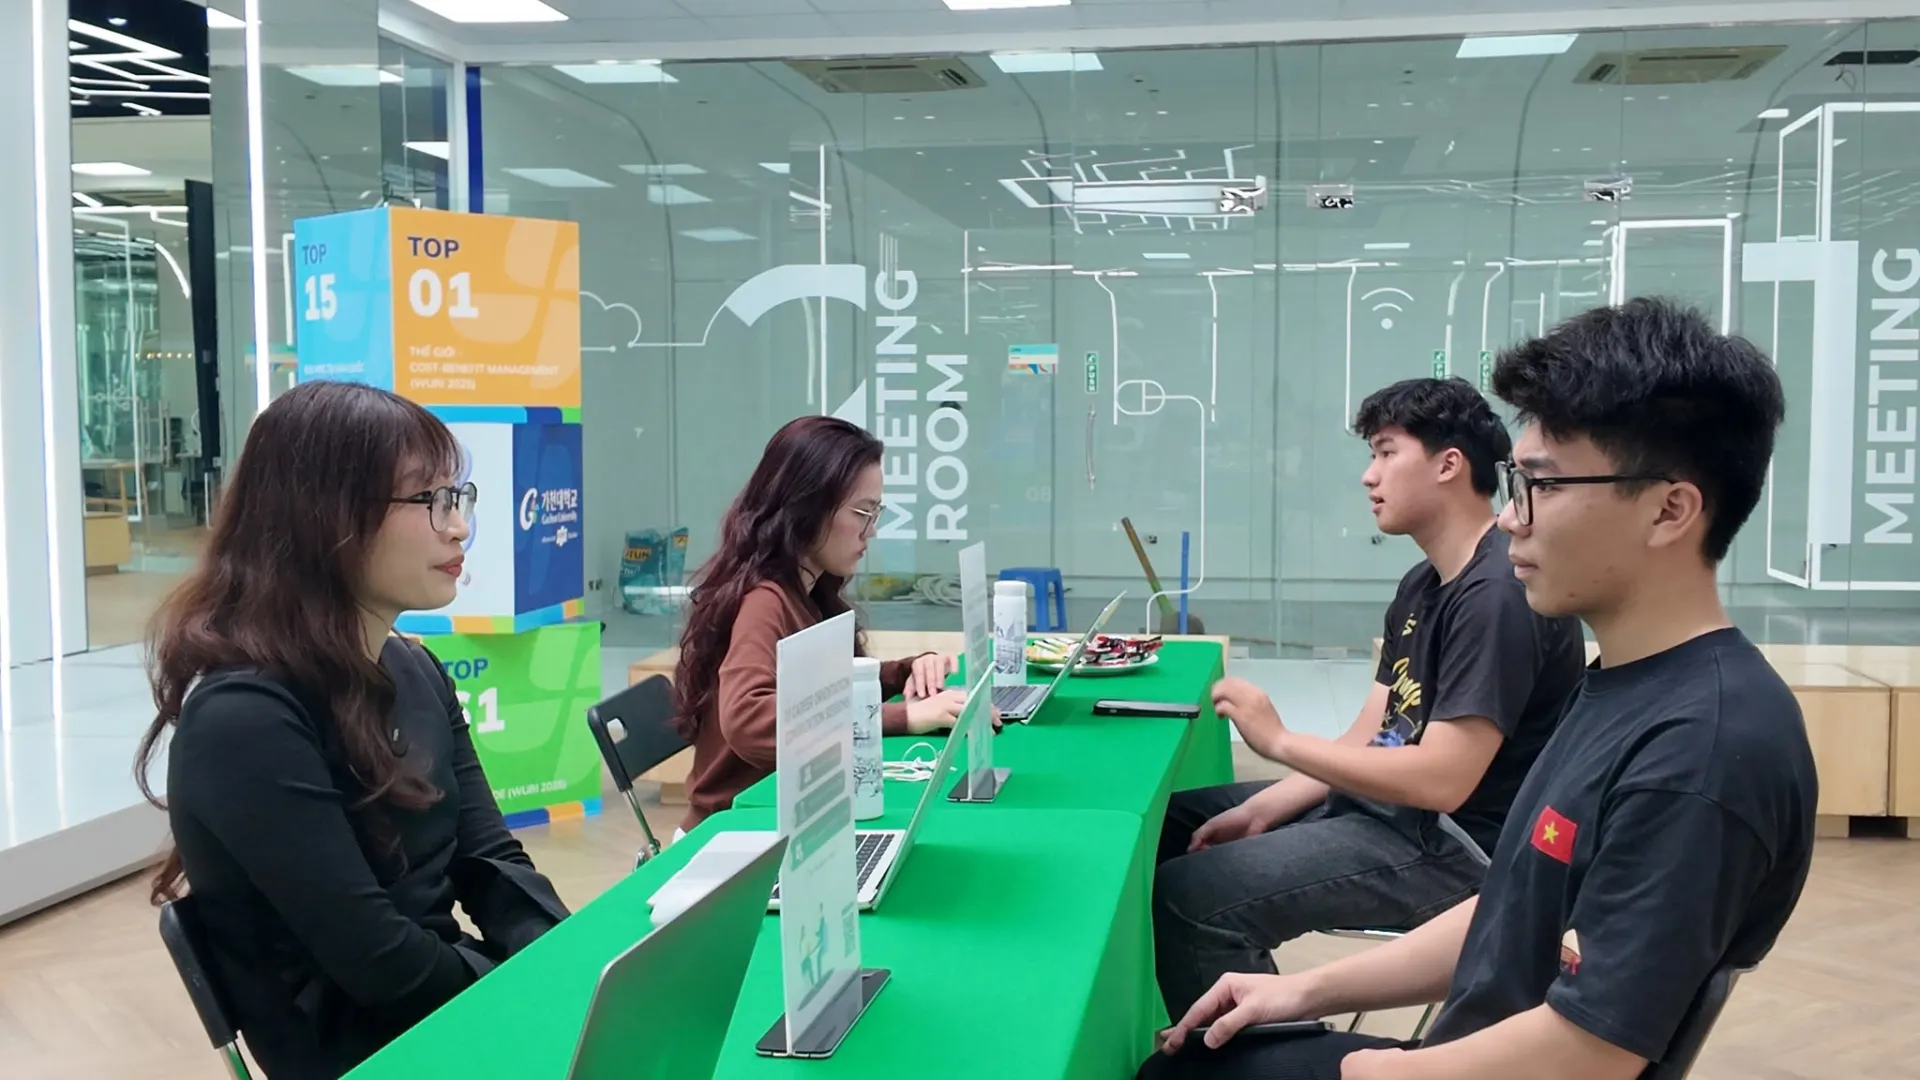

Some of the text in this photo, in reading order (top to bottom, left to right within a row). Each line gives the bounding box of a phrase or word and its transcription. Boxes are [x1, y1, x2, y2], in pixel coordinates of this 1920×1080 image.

[302, 243, 328, 265] TOP
[408, 236, 460, 259] TOP
[305, 273, 338, 321] 15
[408, 269, 479, 319] 01
[487, 364, 559, 376] MANAGEMENT
[874, 269, 918, 540] MEETING
[1864, 248, 1920, 544] MEETING
[926, 354, 968, 540] ROOM
[442, 658, 489, 680] TOP
